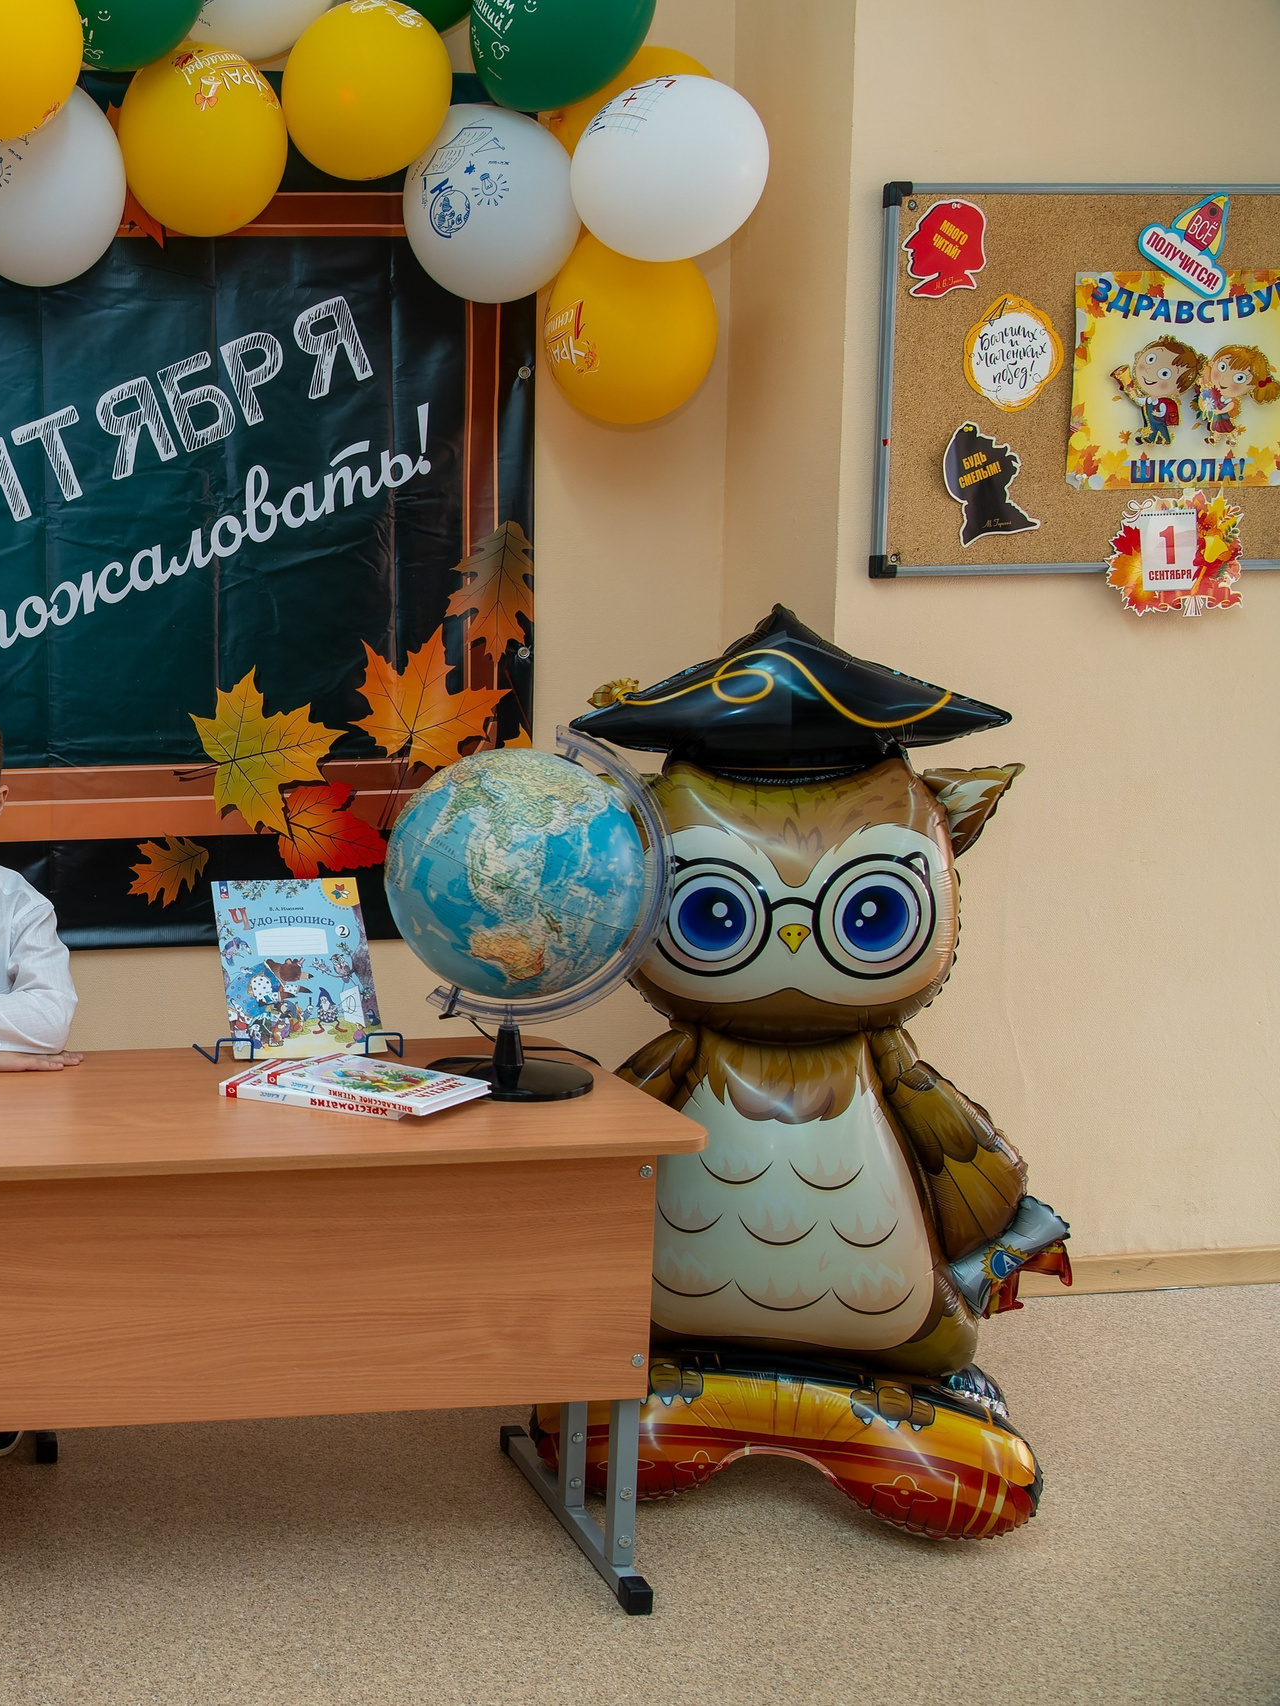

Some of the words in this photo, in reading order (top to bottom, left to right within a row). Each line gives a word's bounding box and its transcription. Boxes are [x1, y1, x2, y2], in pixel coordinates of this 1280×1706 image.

[219, 68, 269, 91] УРА!
[939, 219, 969, 246] МНОГО
[1188, 214, 1219, 246] ВСЁ
[932, 233, 962, 260] ЧИТАЙ!
[1145, 231, 1220, 291] ПОЛУЧИТСЯ!
[978, 325, 1038, 351] Больших
[1008, 338, 1020, 348] и
[993, 360, 1035, 390] побед!
[962, 451, 988, 470] БУДЬ
[1130, 457, 1246, 484] ШКОЛА!
[958, 461, 1002, 489] СМЕЛЫМ!
[1158, 525, 1176, 565] 1
[1148, 568, 1192, 581] СЕНТЯБРЯ
[228, 907, 336, 931] Чудо-пропись
[339, 926, 347, 936] 2
[310, 1097, 388, 1117] ХРЕСТОМАТИЯ
[328, 1088, 357, 1101] ЧТЕНИЕ
[358, 1095, 413, 1113] ВНЕКЛАССНОЕ
